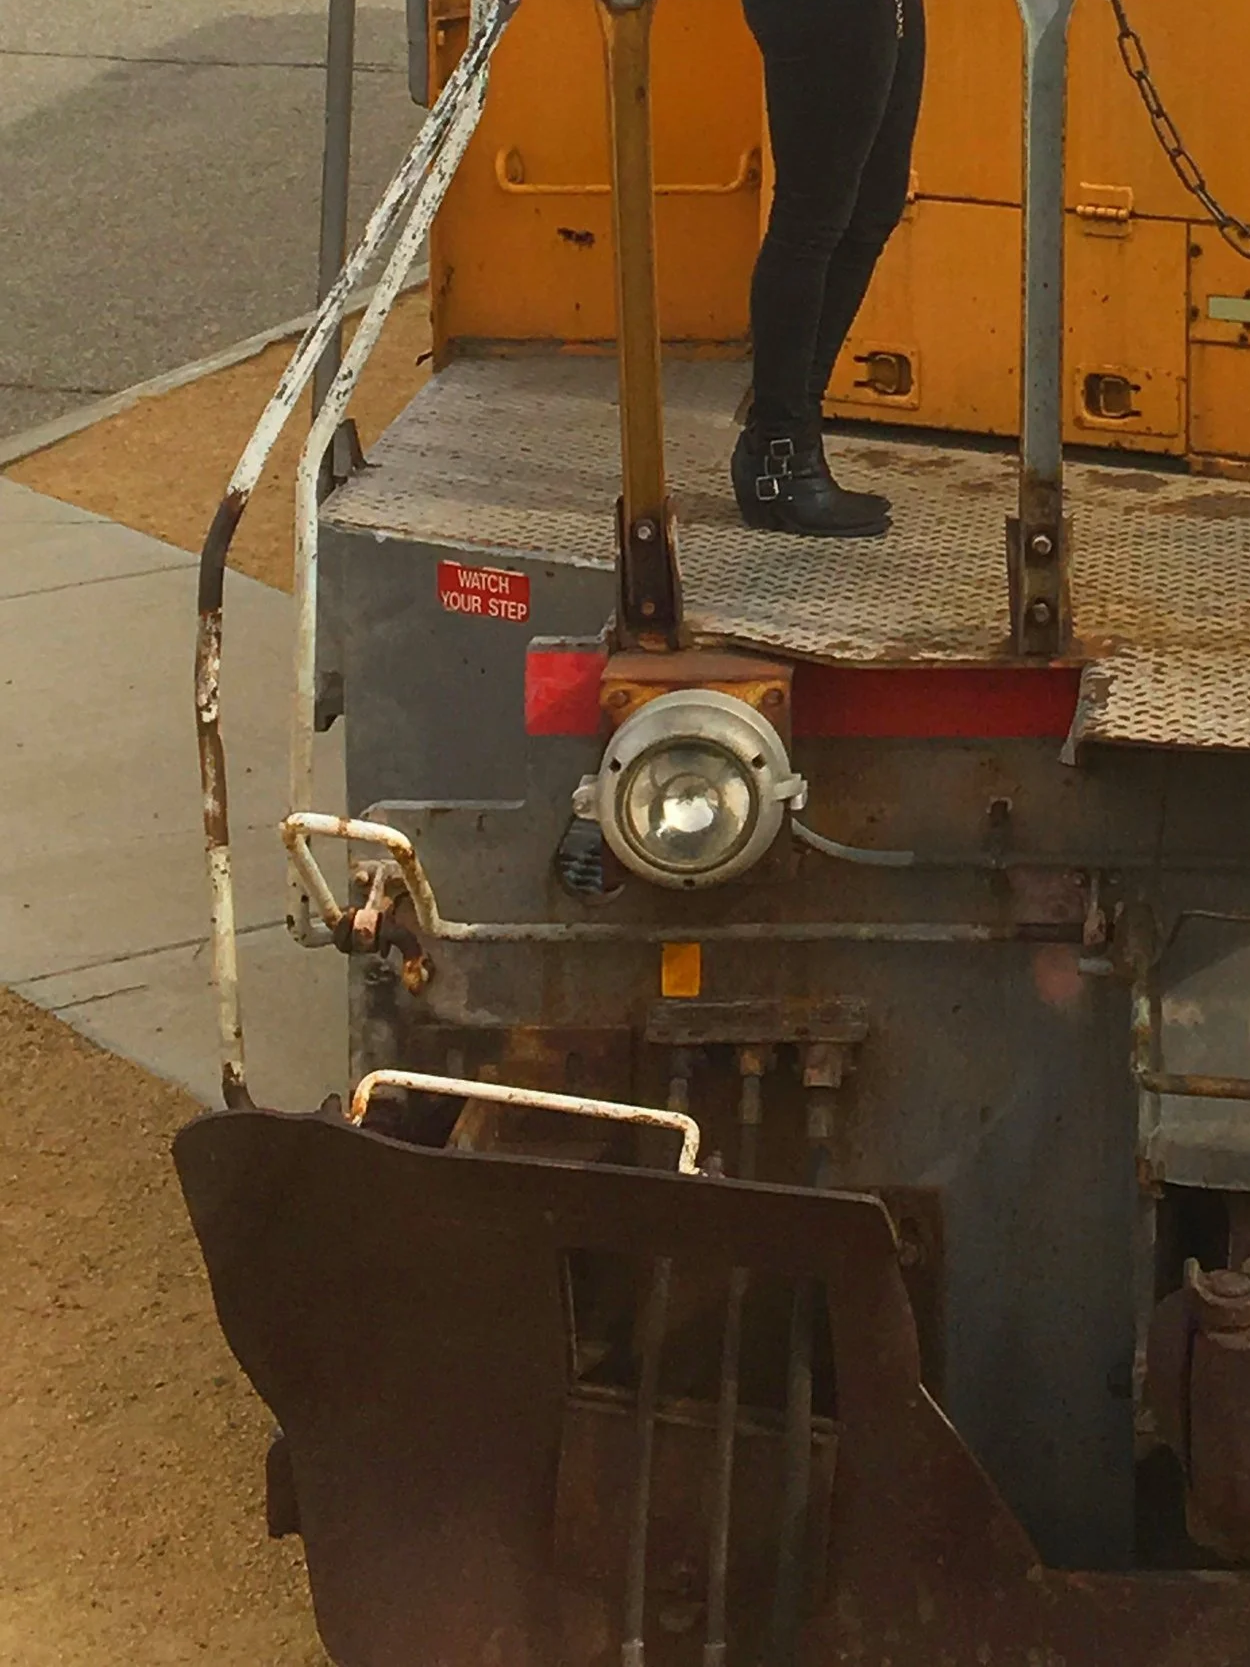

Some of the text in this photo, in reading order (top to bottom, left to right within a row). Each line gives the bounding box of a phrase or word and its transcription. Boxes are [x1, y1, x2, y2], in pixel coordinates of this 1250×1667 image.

[457, 570, 510, 594] WATCH
[441, 591, 527, 620] YOUR STEP
